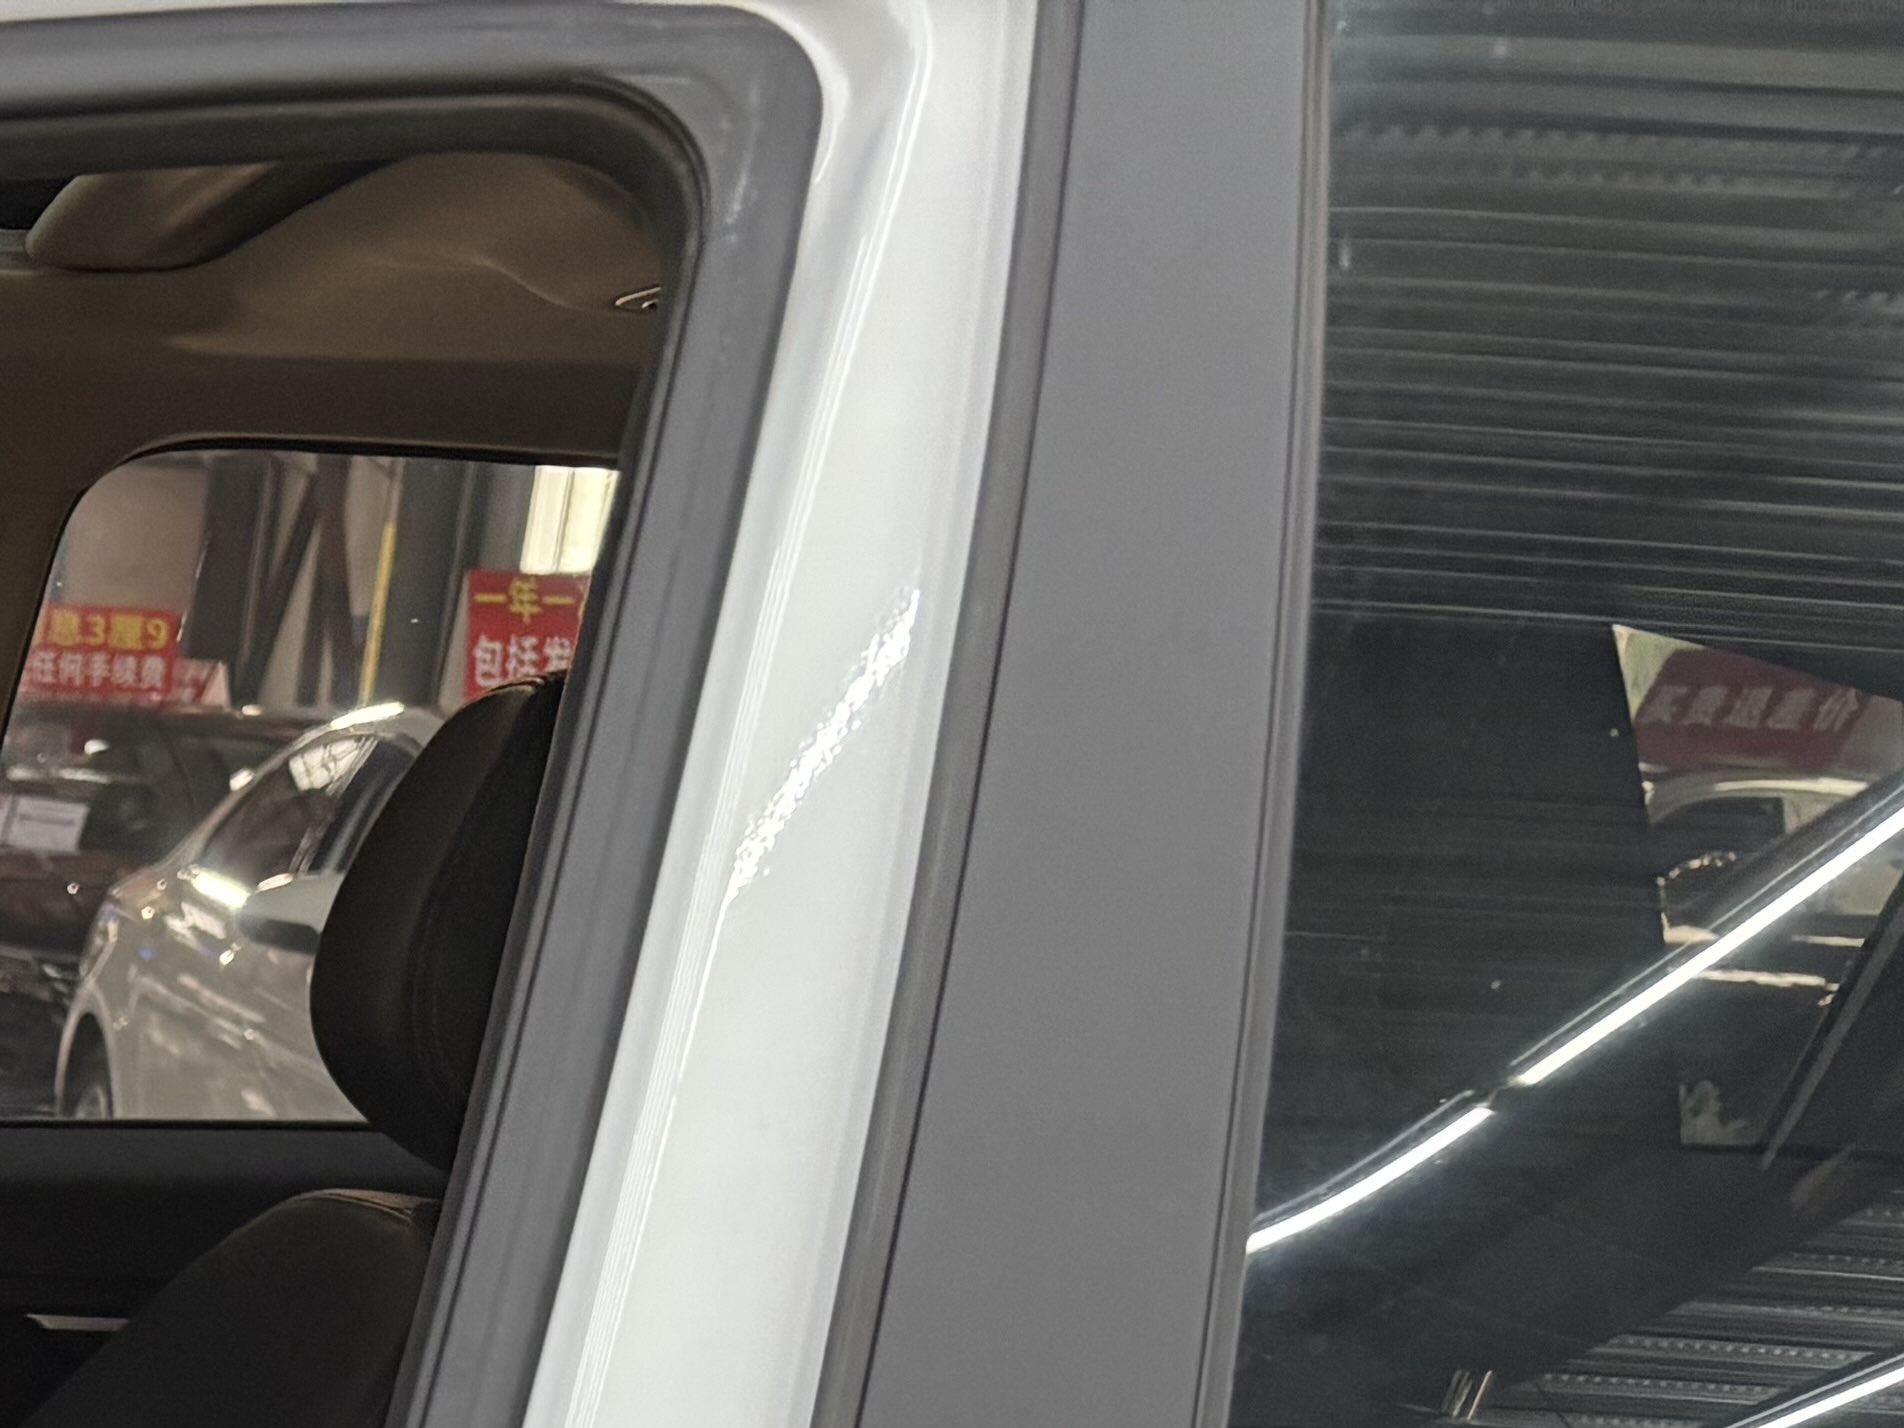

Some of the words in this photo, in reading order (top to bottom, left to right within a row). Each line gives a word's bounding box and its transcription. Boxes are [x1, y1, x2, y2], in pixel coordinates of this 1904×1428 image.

[1641, 685, 1860, 733] 买贵退差价
